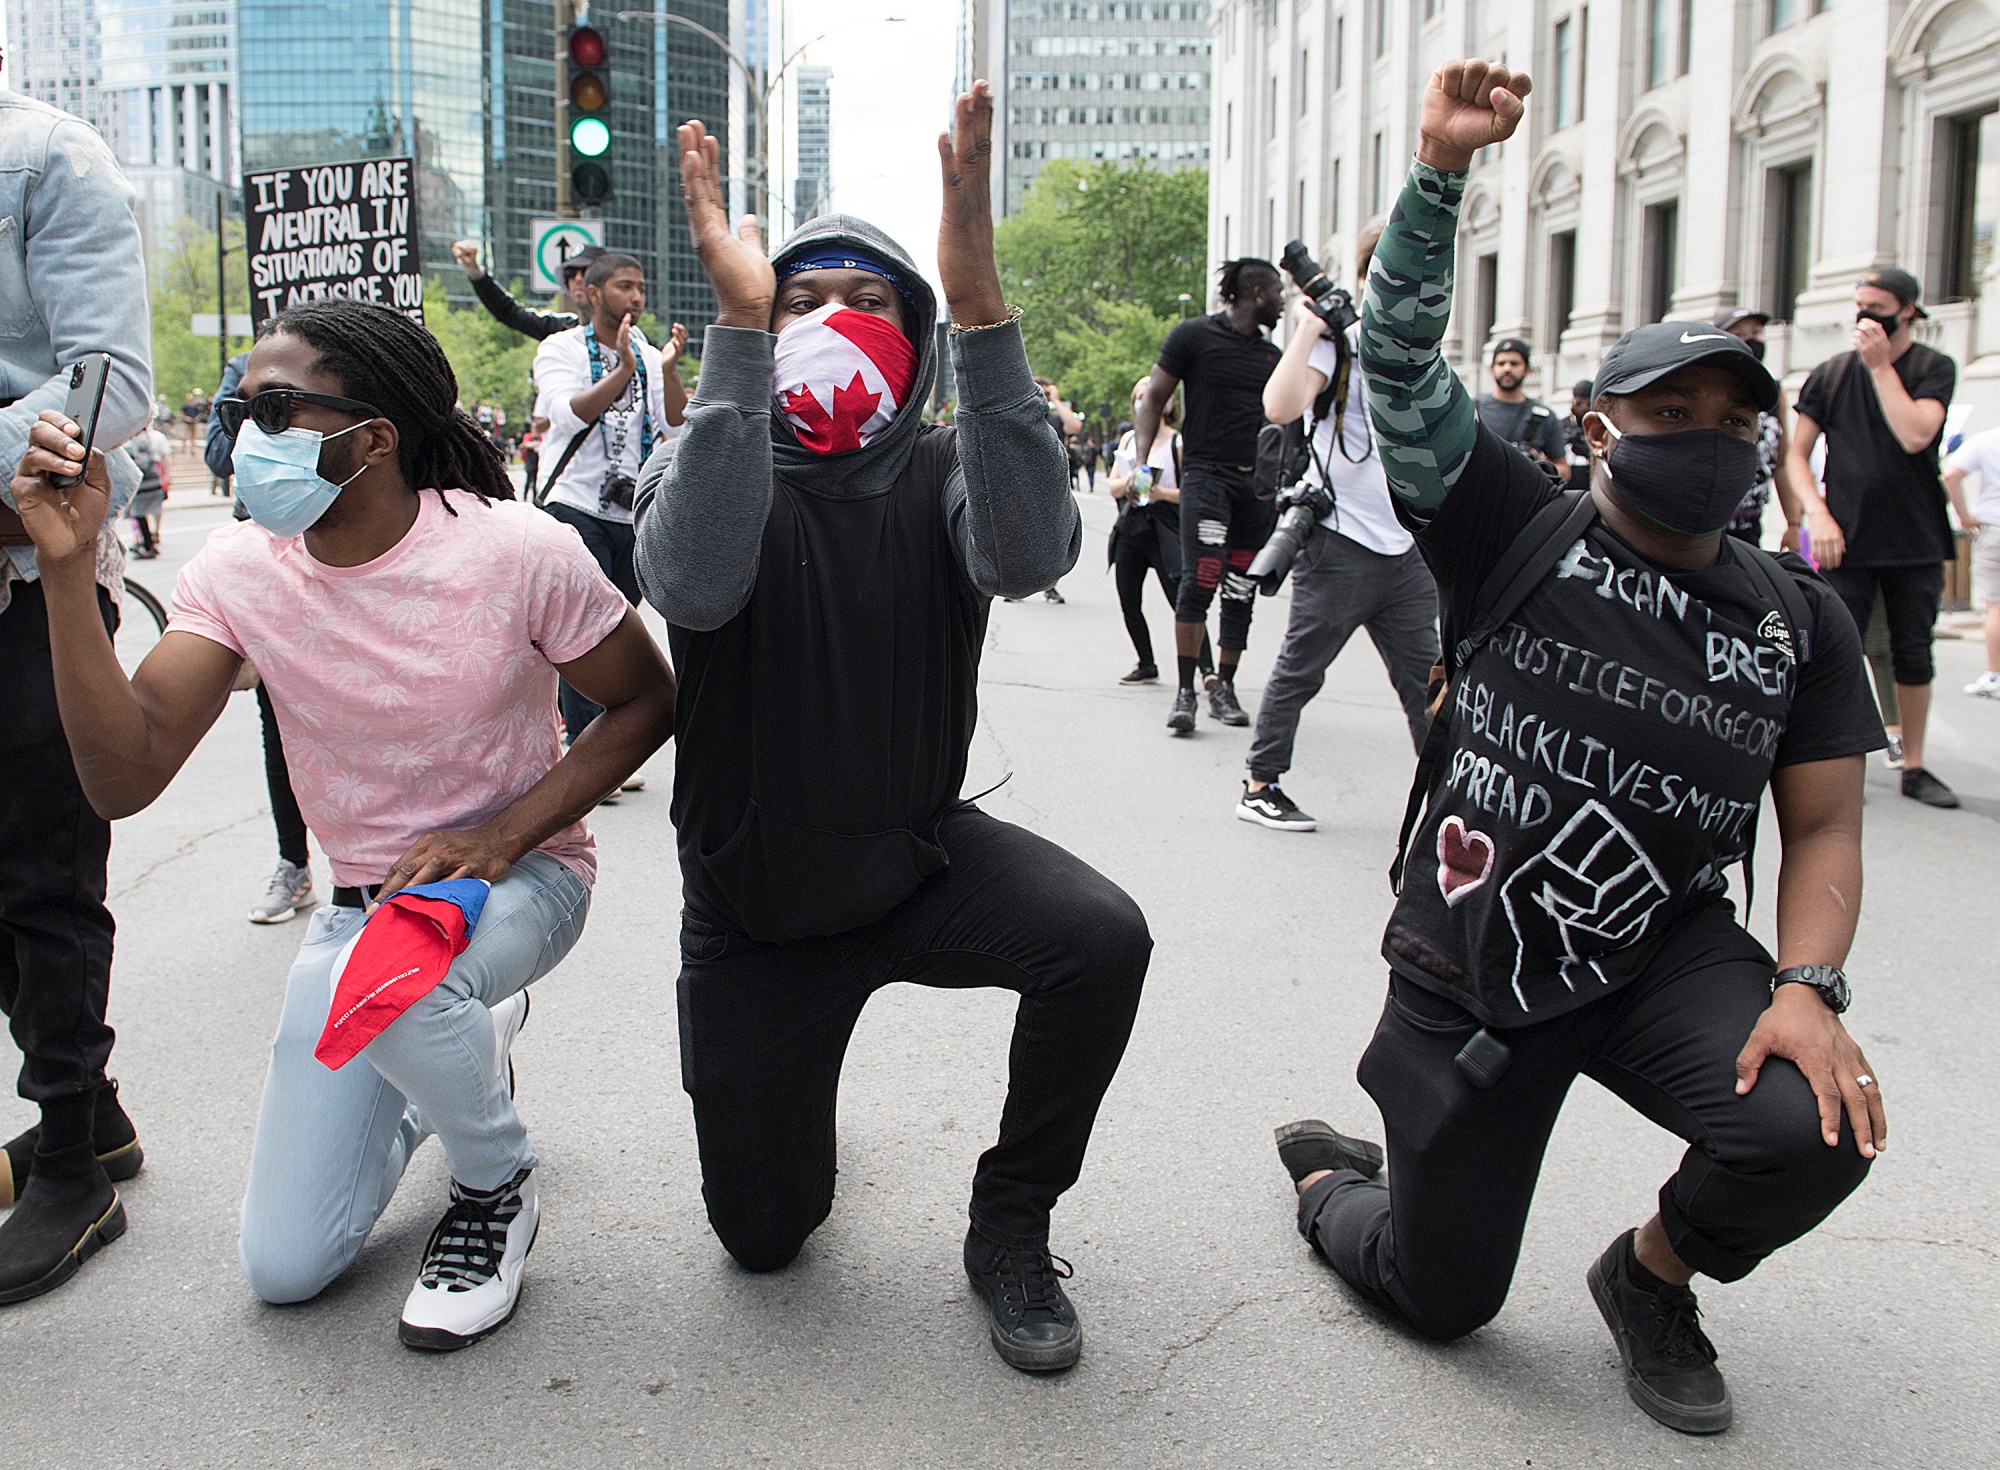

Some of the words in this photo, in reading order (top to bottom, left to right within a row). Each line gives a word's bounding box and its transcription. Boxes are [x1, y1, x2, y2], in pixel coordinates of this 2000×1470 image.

[251, 171, 291, 213] IF
[301, 166, 353, 206] YOU
[360, 161, 409, 199] ARE
[260, 202, 371, 251] NEUTRAL
[370, 197, 409, 238] IN
[251, 243, 363, 287] SITUATIONS
[372, 238, 408, 273] OF
[388, 273, 422, 308] YOU
[1446, 747, 1553, 829] SPREAD
